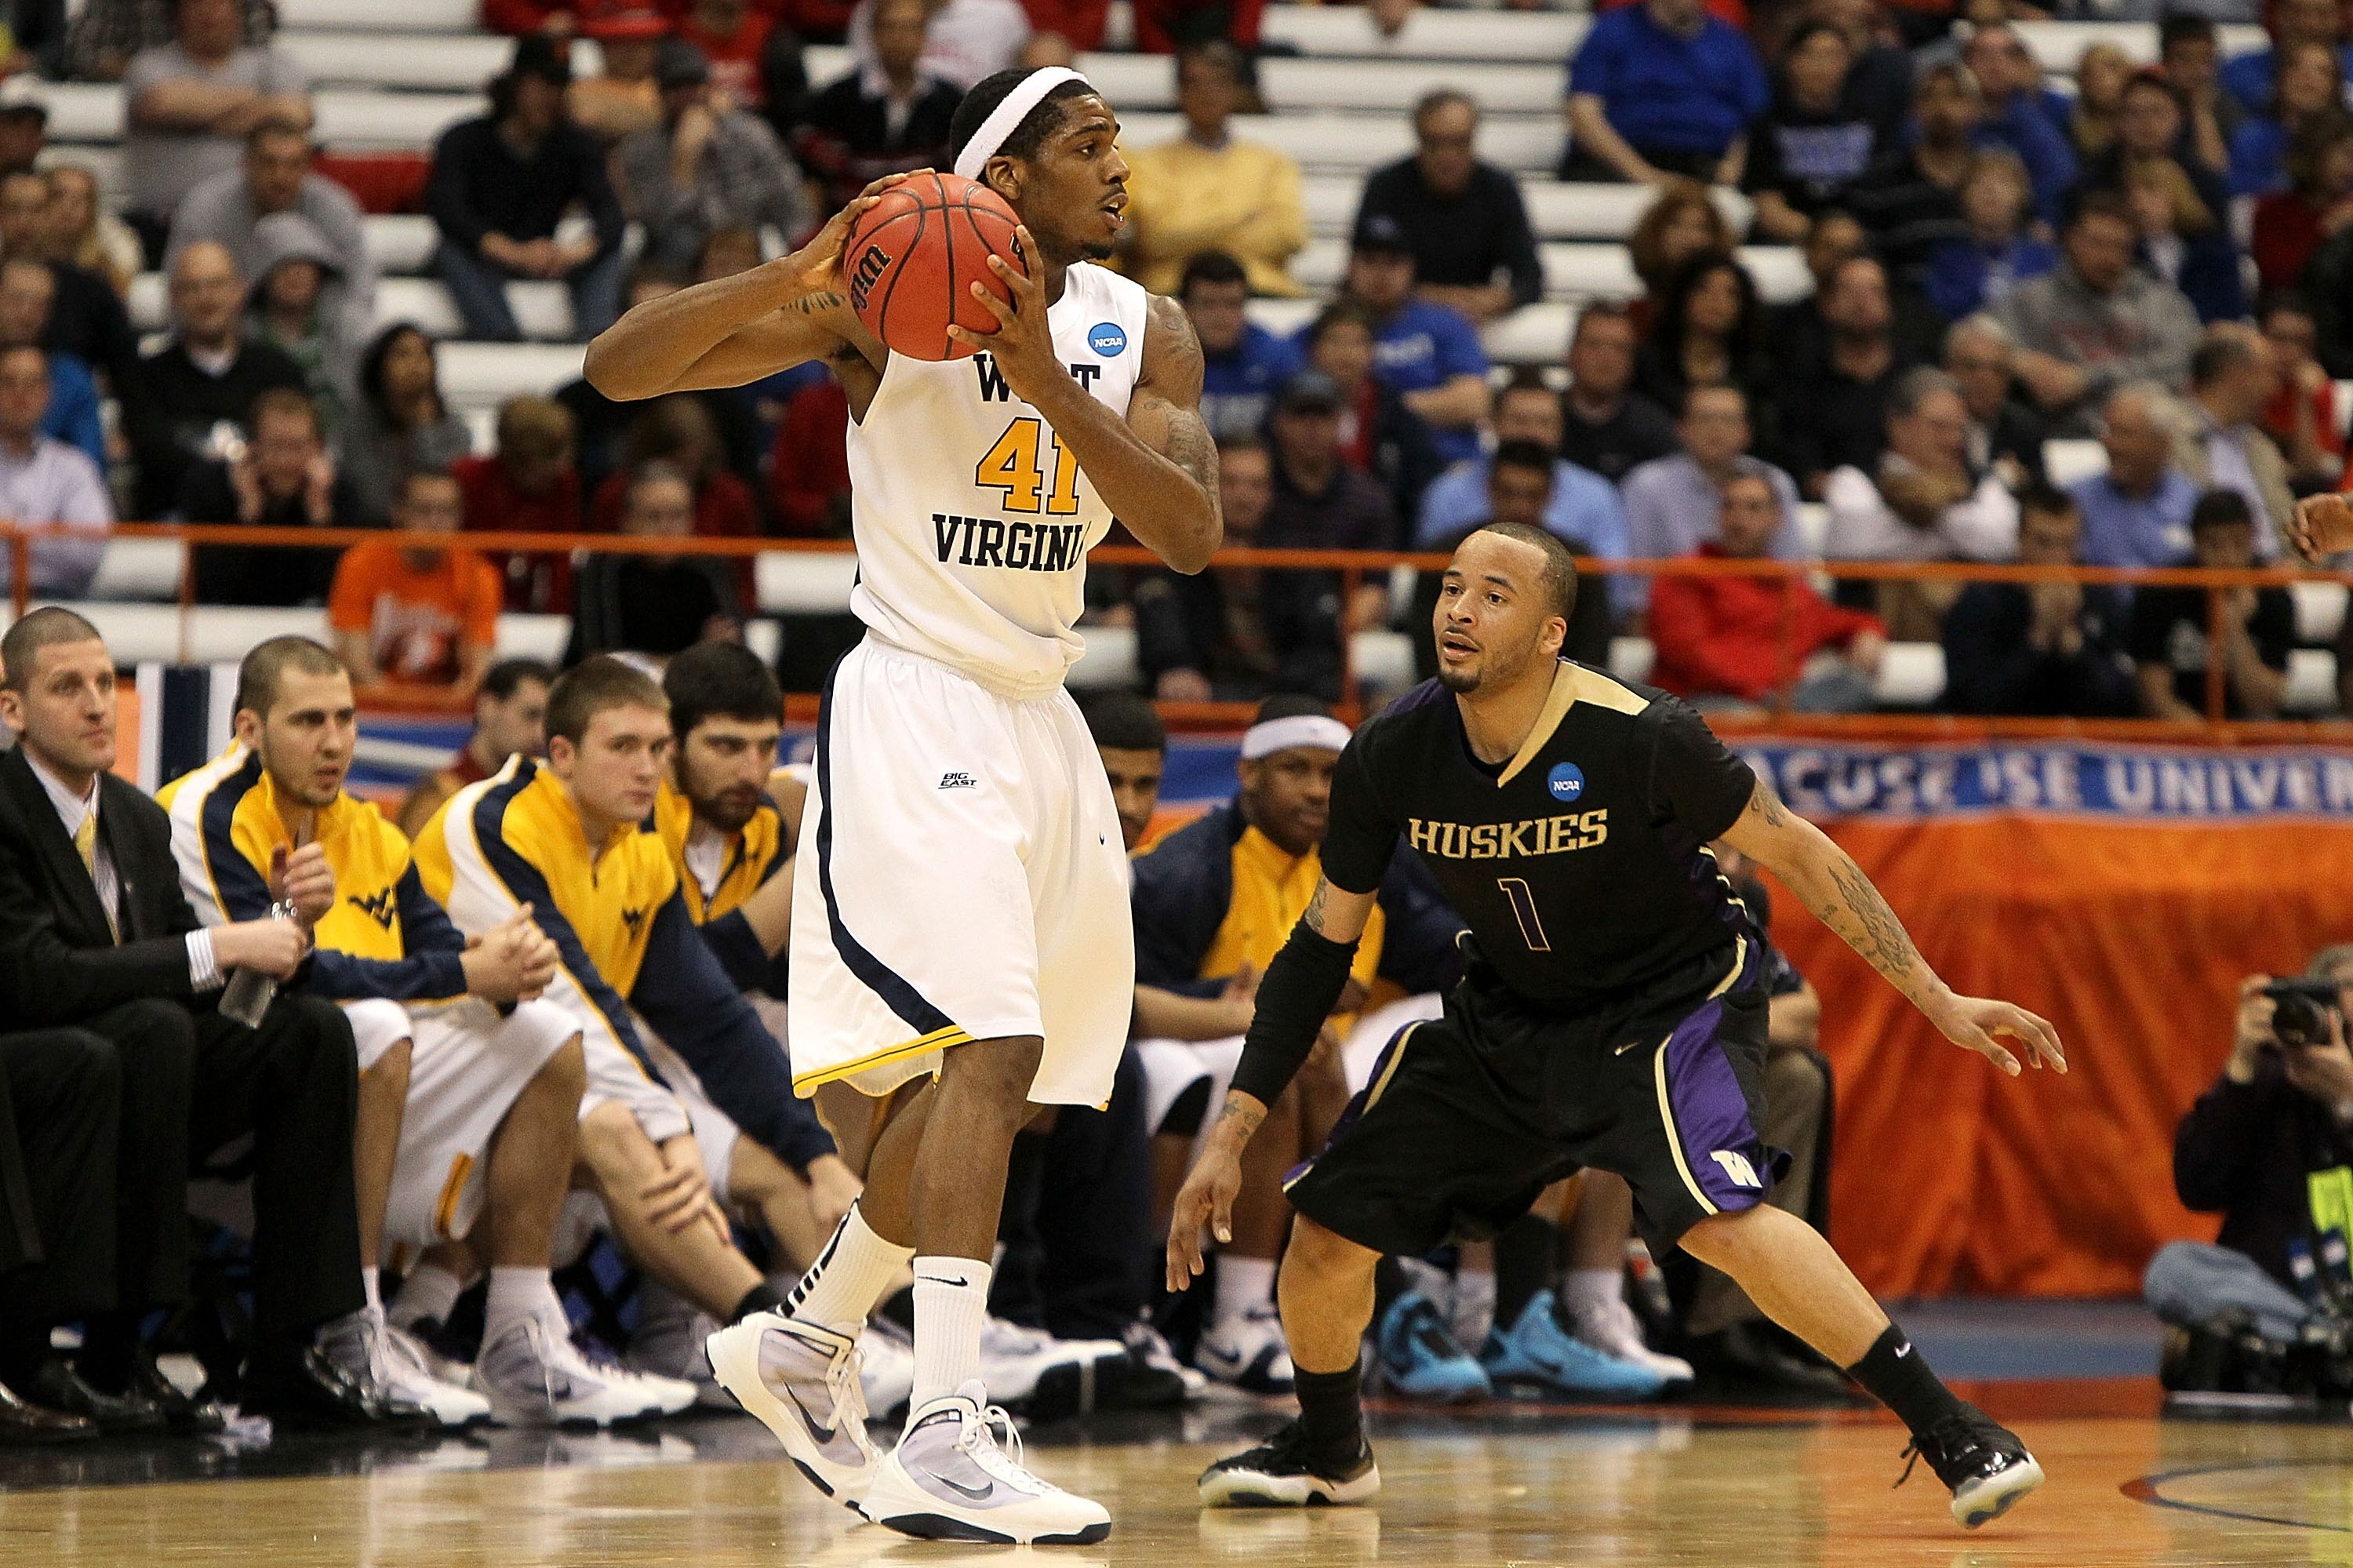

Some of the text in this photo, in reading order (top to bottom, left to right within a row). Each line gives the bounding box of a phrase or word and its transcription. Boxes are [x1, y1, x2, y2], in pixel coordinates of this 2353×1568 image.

[1094, 337, 1123, 347] NCAA
[973, 354, 1100, 402] WT
[975, 417, 1079, 515] 41
[1553, 780, 1580, 791] NCAA
[1409, 809, 1608, 859] HUSKIES
[1497, 878, 1551, 951] 1
[1710, 1150, 1763, 1188] W
